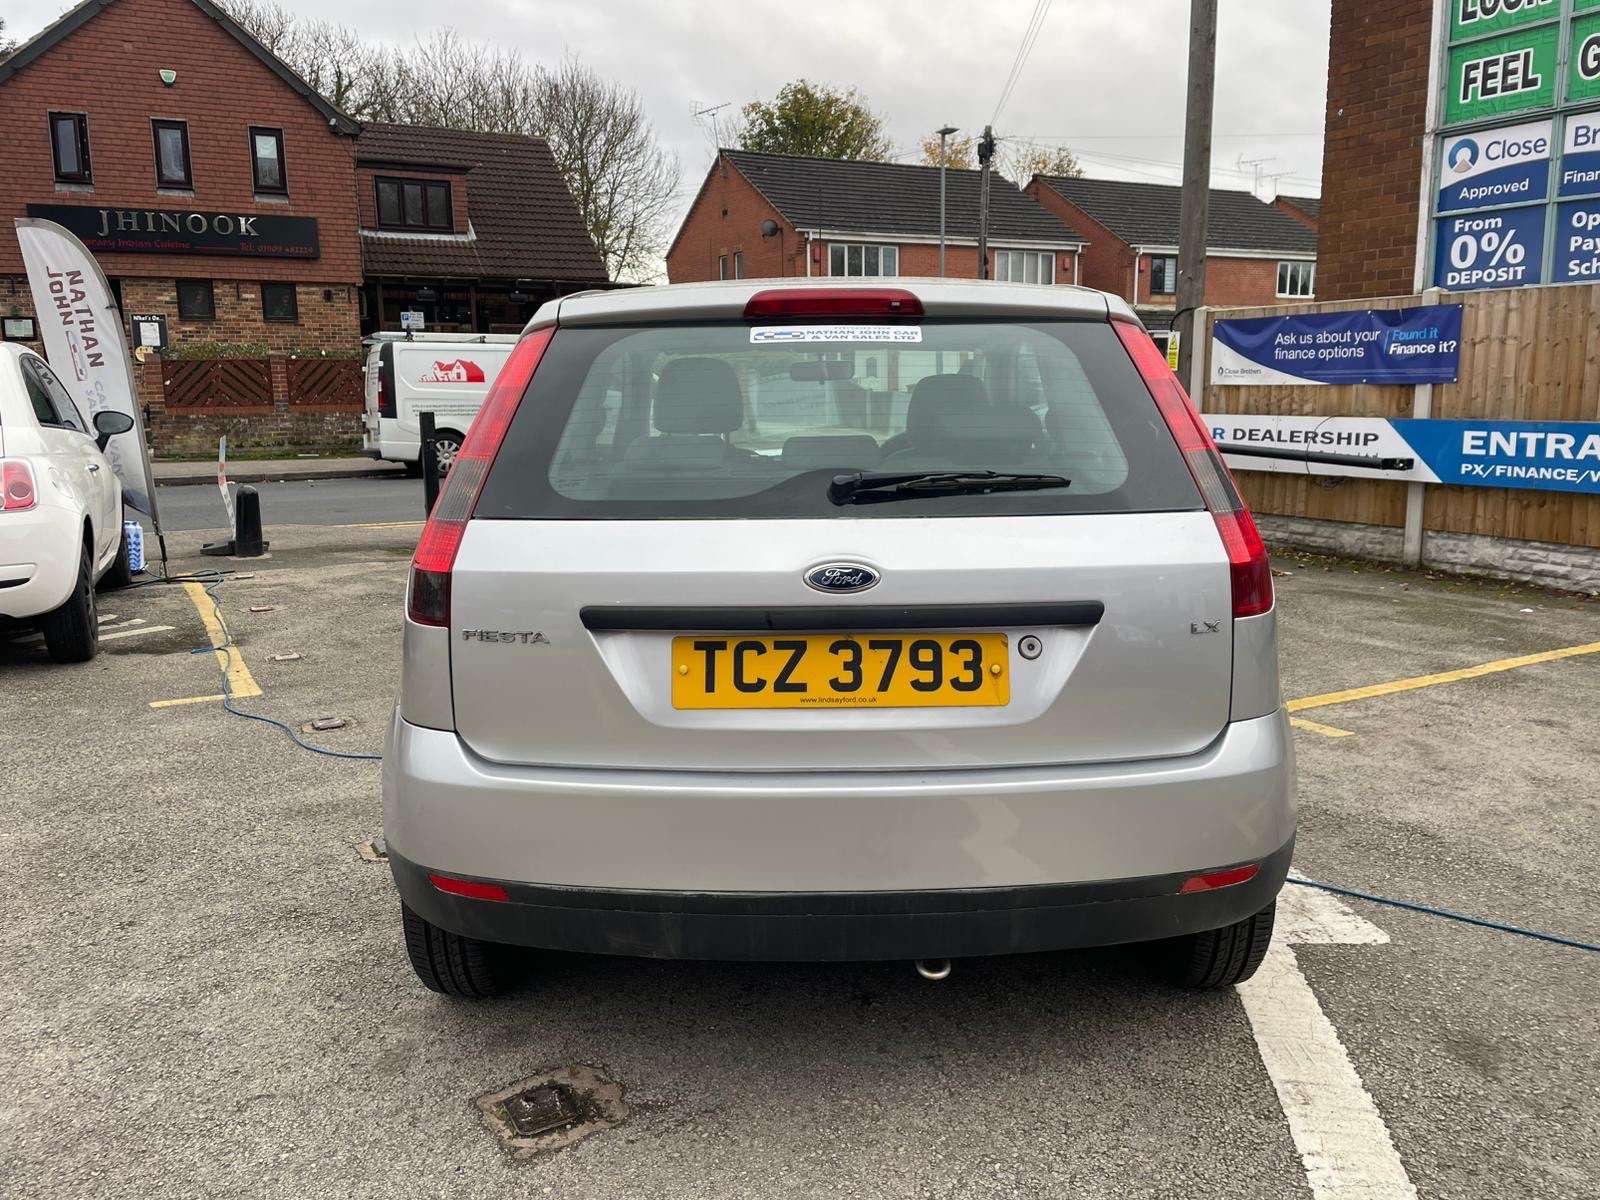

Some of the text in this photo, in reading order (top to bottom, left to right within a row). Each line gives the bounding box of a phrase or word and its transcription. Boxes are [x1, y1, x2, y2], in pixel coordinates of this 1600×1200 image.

[1460, 49, 1541, 103] FEEL
[1485, 137, 1547, 160] Close
[1459, 178, 1529, 200] Approved
[98, 210, 259, 237] JHINOOK
[1454, 218, 1502, 232] From
[1451, 229, 1525, 269] 0%
[1447, 266, 1526, 286] DEPOSIT
[47, 266, 74, 326] JOHN
[66, 270, 104, 368] NATHAN
[1274, 330, 1381, 346] Ask us about your
[1392, 327, 1438, 340] Found it
[1274, 345, 1365, 361] finance options
[1389, 340, 1457, 354] Finance it?
[1232, 427, 1379, 447] DEALERSHIP
[1461, 430, 1600, 463] ENTRA
[820, 567, 863, 586] Ford
[462, 629, 551, 645] FIESTA
[1191, 620, 1220, 635] LX
[694, 638, 983, 693] TCZ 3793
[800, 696, 877, 705] www.lindsayford.co.uk
